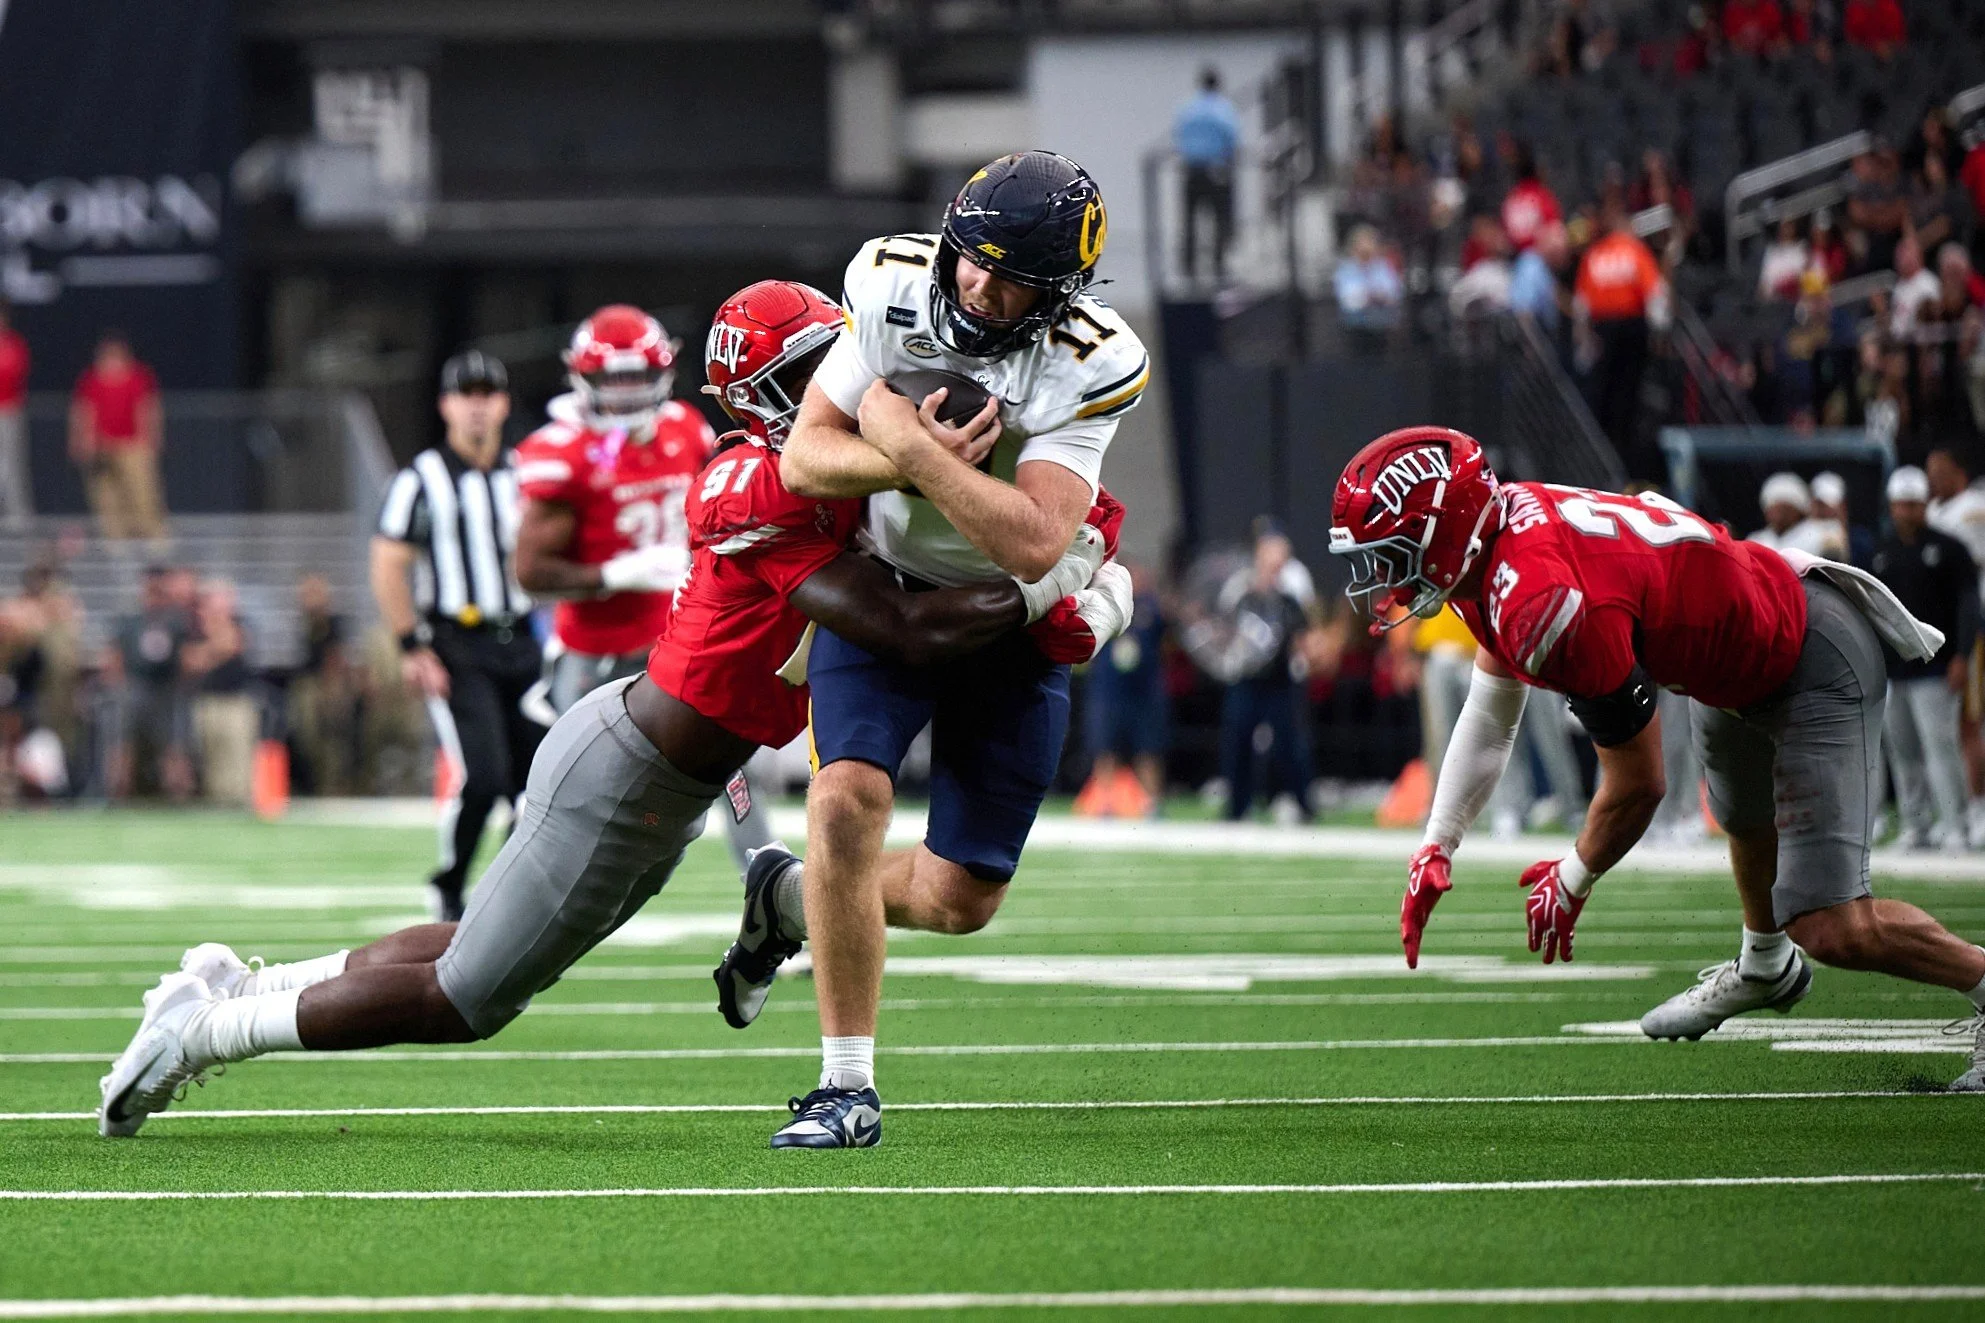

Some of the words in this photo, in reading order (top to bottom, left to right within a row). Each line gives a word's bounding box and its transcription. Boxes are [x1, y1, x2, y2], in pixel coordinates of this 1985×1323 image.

[874, 235, 936, 268] 11
[976, 243, 1007, 260] ACC
[705, 320, 745, 374] NLV
[909, 341, 938, 352] ACC
[1047, 306, 1118, 363] 11
[1371, 447, 1453, 515] UNLV
